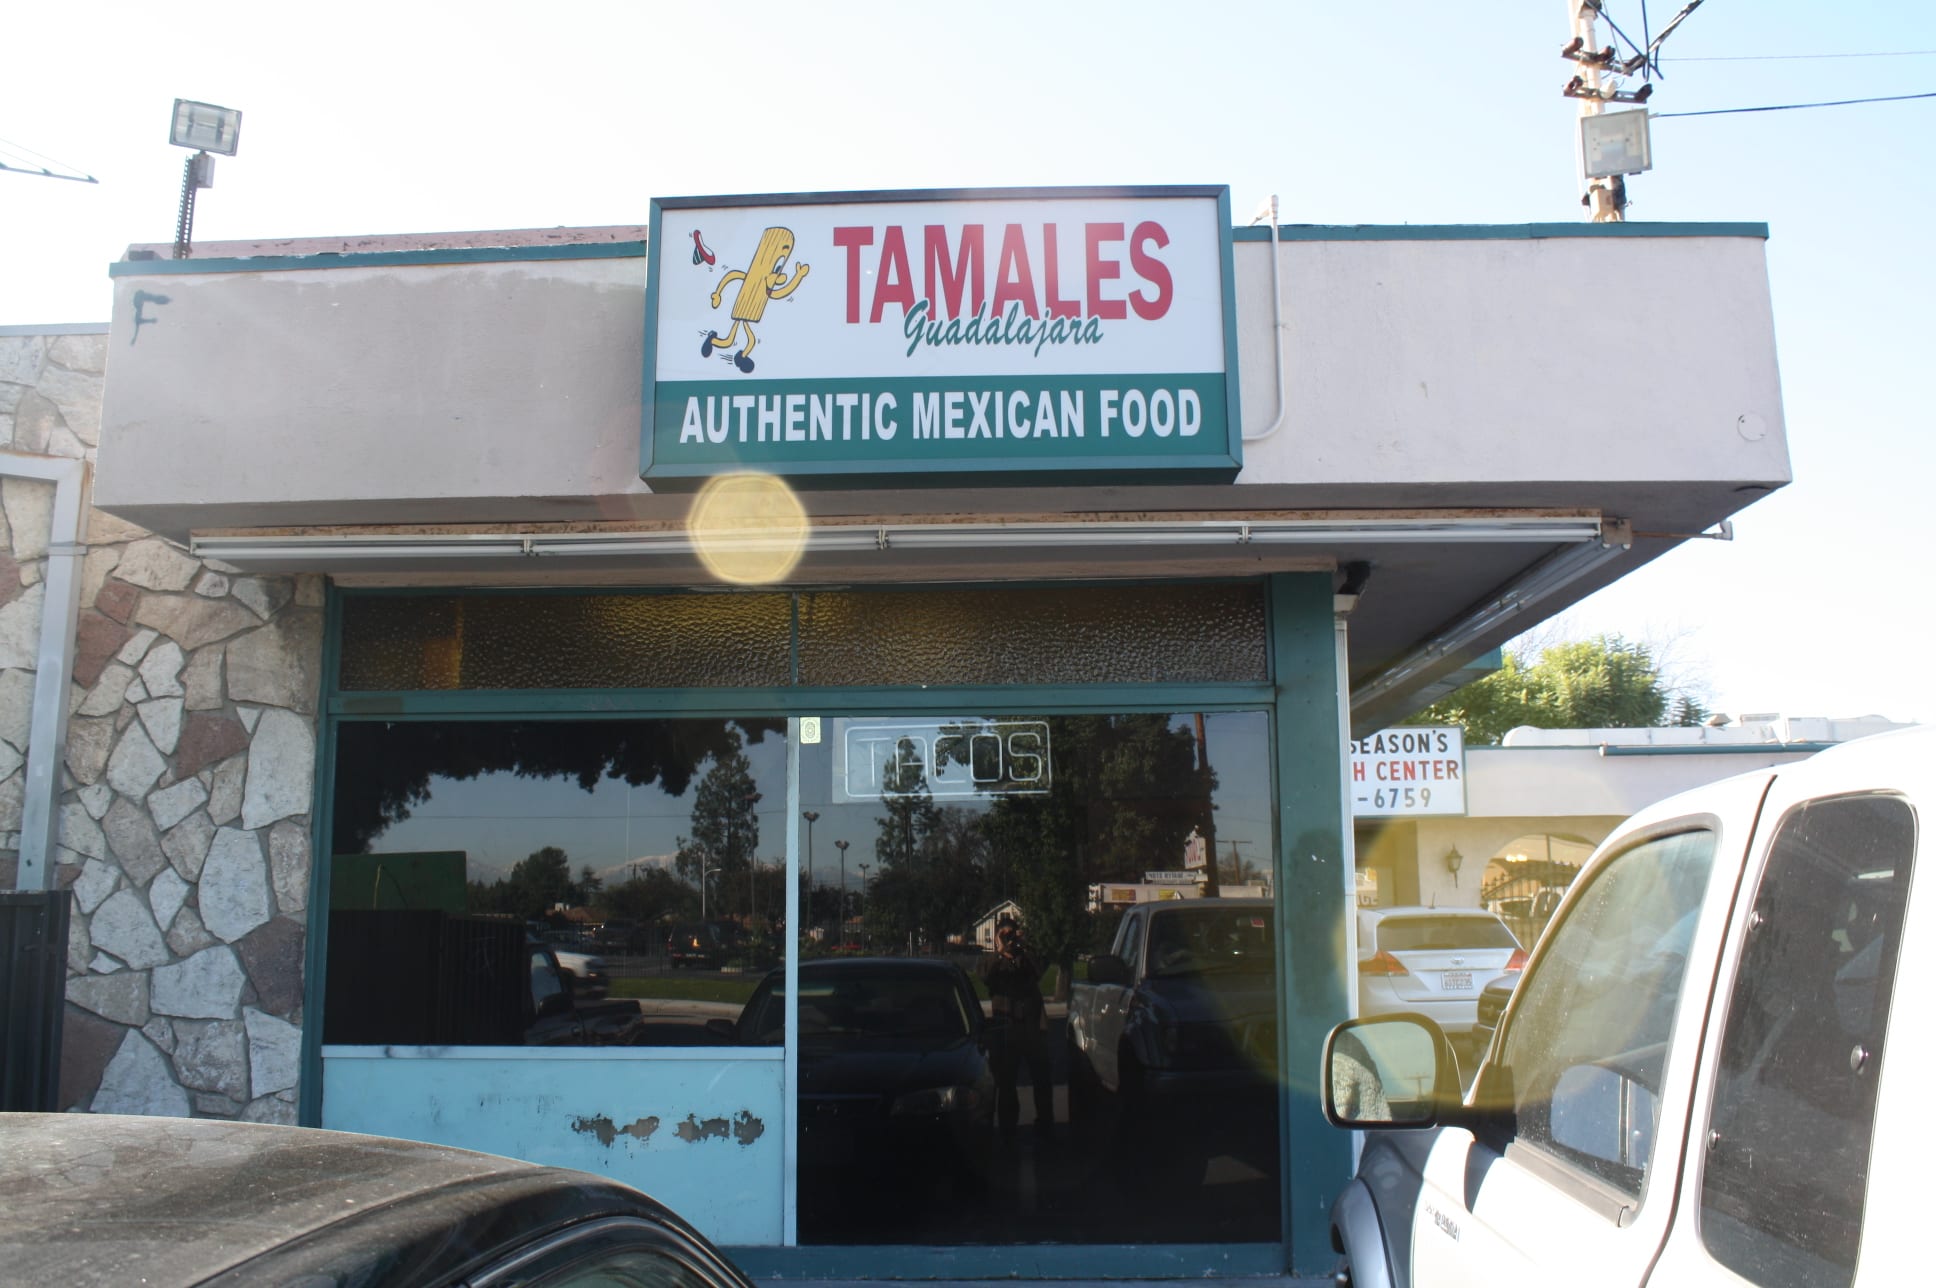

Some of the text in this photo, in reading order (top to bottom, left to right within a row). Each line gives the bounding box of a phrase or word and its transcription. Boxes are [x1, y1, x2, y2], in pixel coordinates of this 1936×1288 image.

[833, 221, 1174, 324] TAMALES
[903, 300, 1104, 358] Guadalajara
[680, 388, 1202, 443] AUTHENTIC MEXICAN FOOD
[856, 733, 1042, 788] TACOS
[1376, 759, 1460, 782] CENTER
